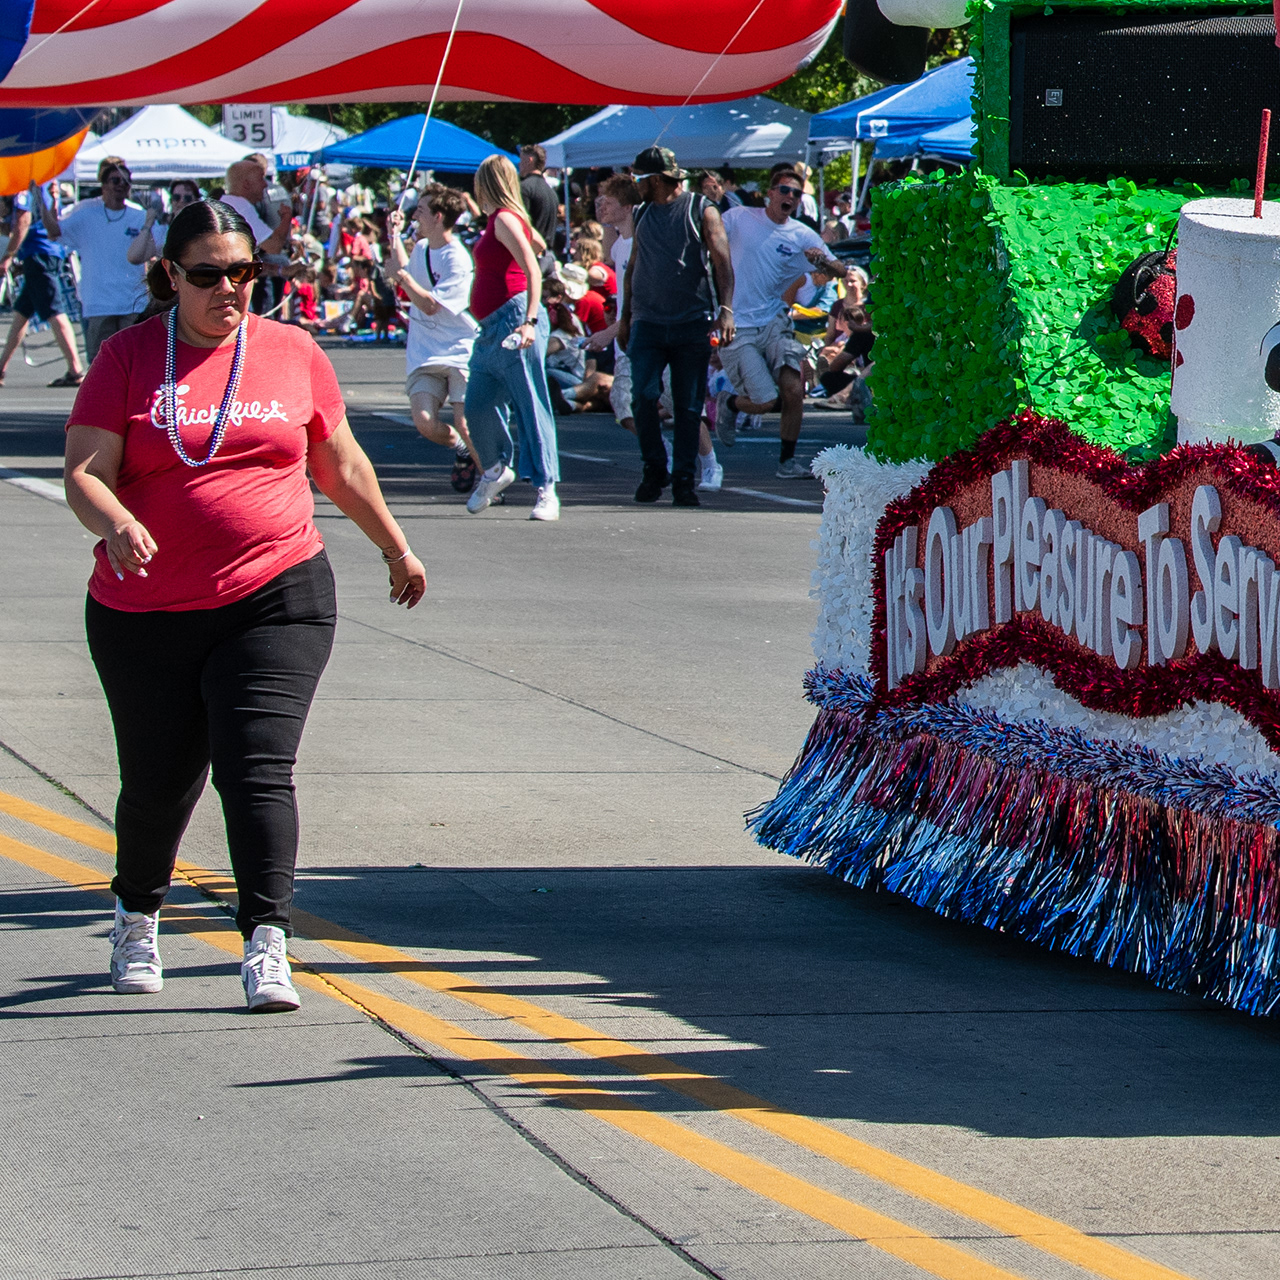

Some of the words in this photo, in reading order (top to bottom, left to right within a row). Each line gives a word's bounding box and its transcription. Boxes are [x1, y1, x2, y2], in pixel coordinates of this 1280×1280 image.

[232, 109, 263, 120] LIMIT
[136, 137, 207, 149] mpm
[233, 123, 267, 143] 35
[150, 394, 289, 429] Chickfil-A
[885, 525, 928, 692] It's
[924, 506, 992, 657] Our
[991, 459, 1143, 669] Pleasure
[1137, 502, 1190, 667] To
